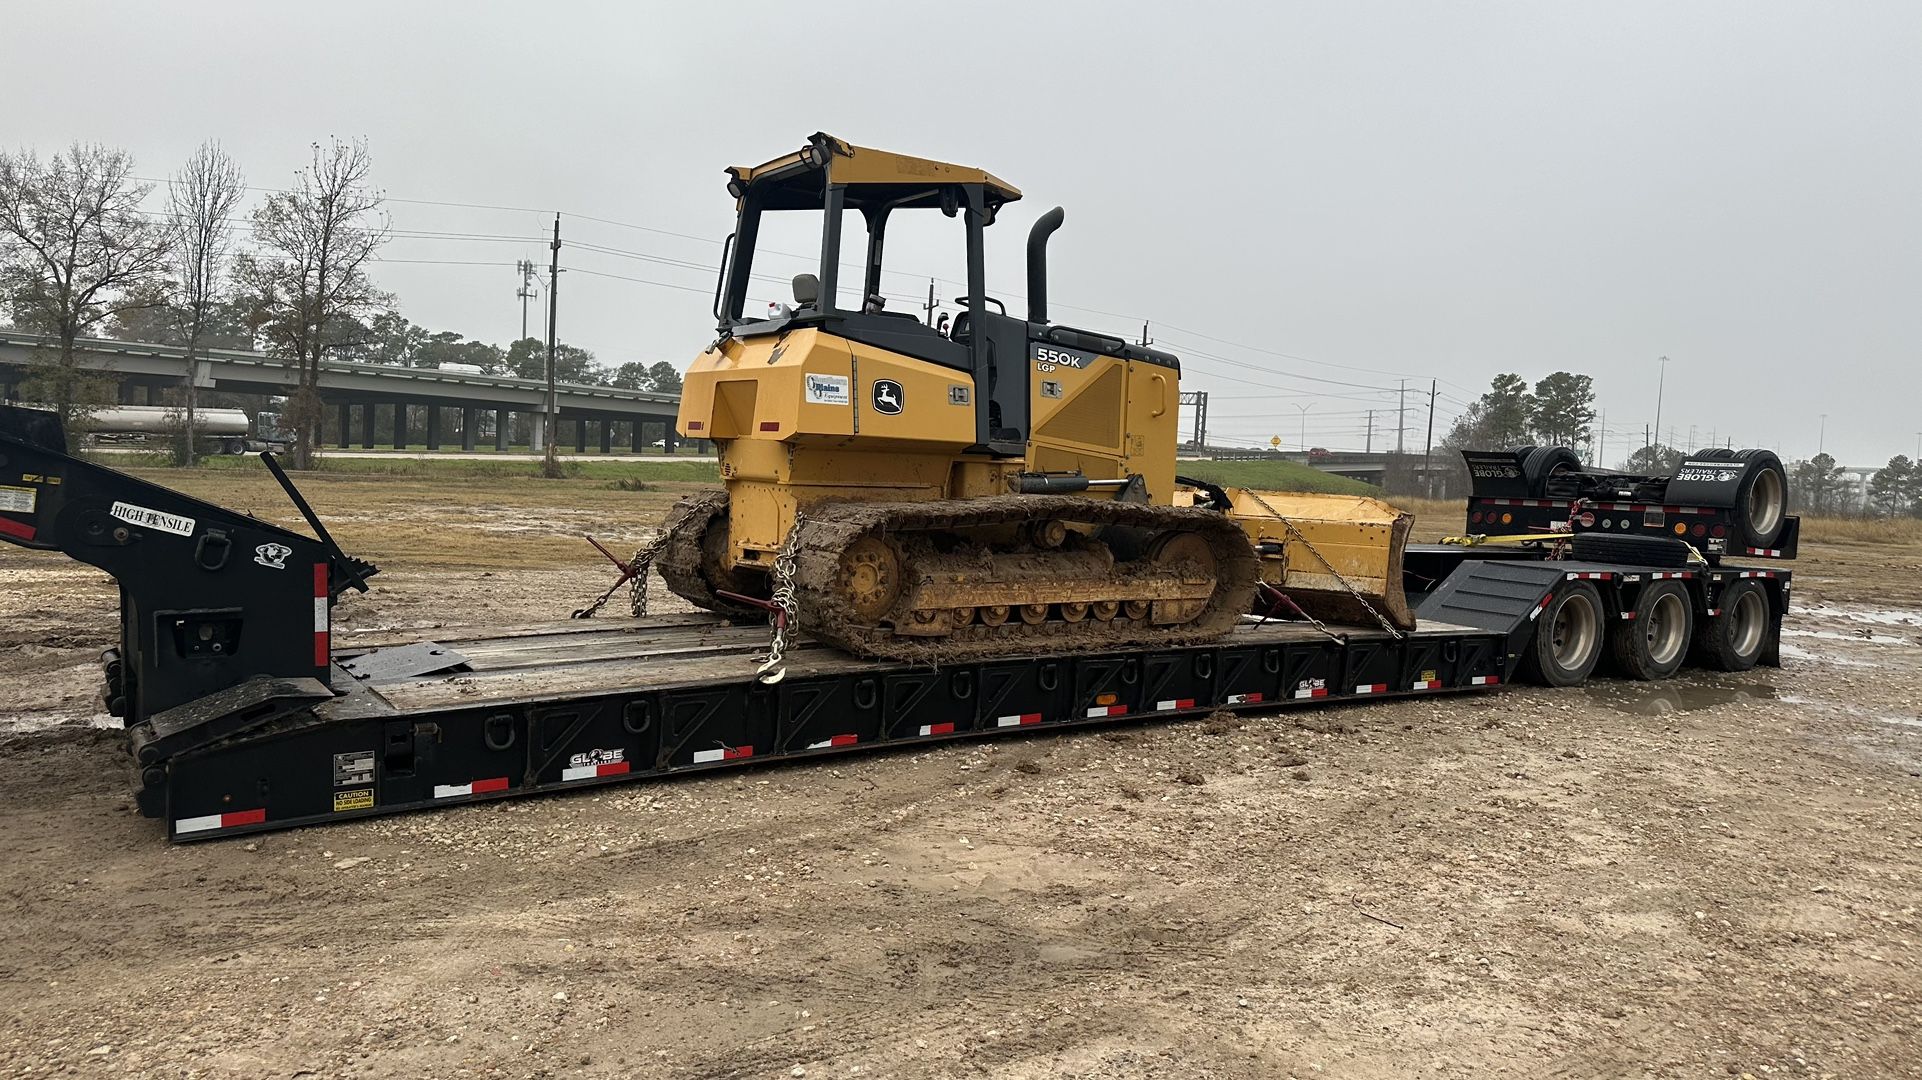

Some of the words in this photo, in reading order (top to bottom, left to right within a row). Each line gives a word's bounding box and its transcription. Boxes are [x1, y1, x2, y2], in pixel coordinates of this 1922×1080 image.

[1037, 347, 1080, 369] 550K
[1037, 362, 1056, 372] LGP
[1473, 469, 1504, 478] GLOBE
[1676, 473, 1715, 481] GLOBE
[113, 505, 144, 522] HIGH
[146, 512, 192, 533] TENSILE
[572, 748, 623, 764] GLOBE
[338, 791, 369, 799] CAUTION
